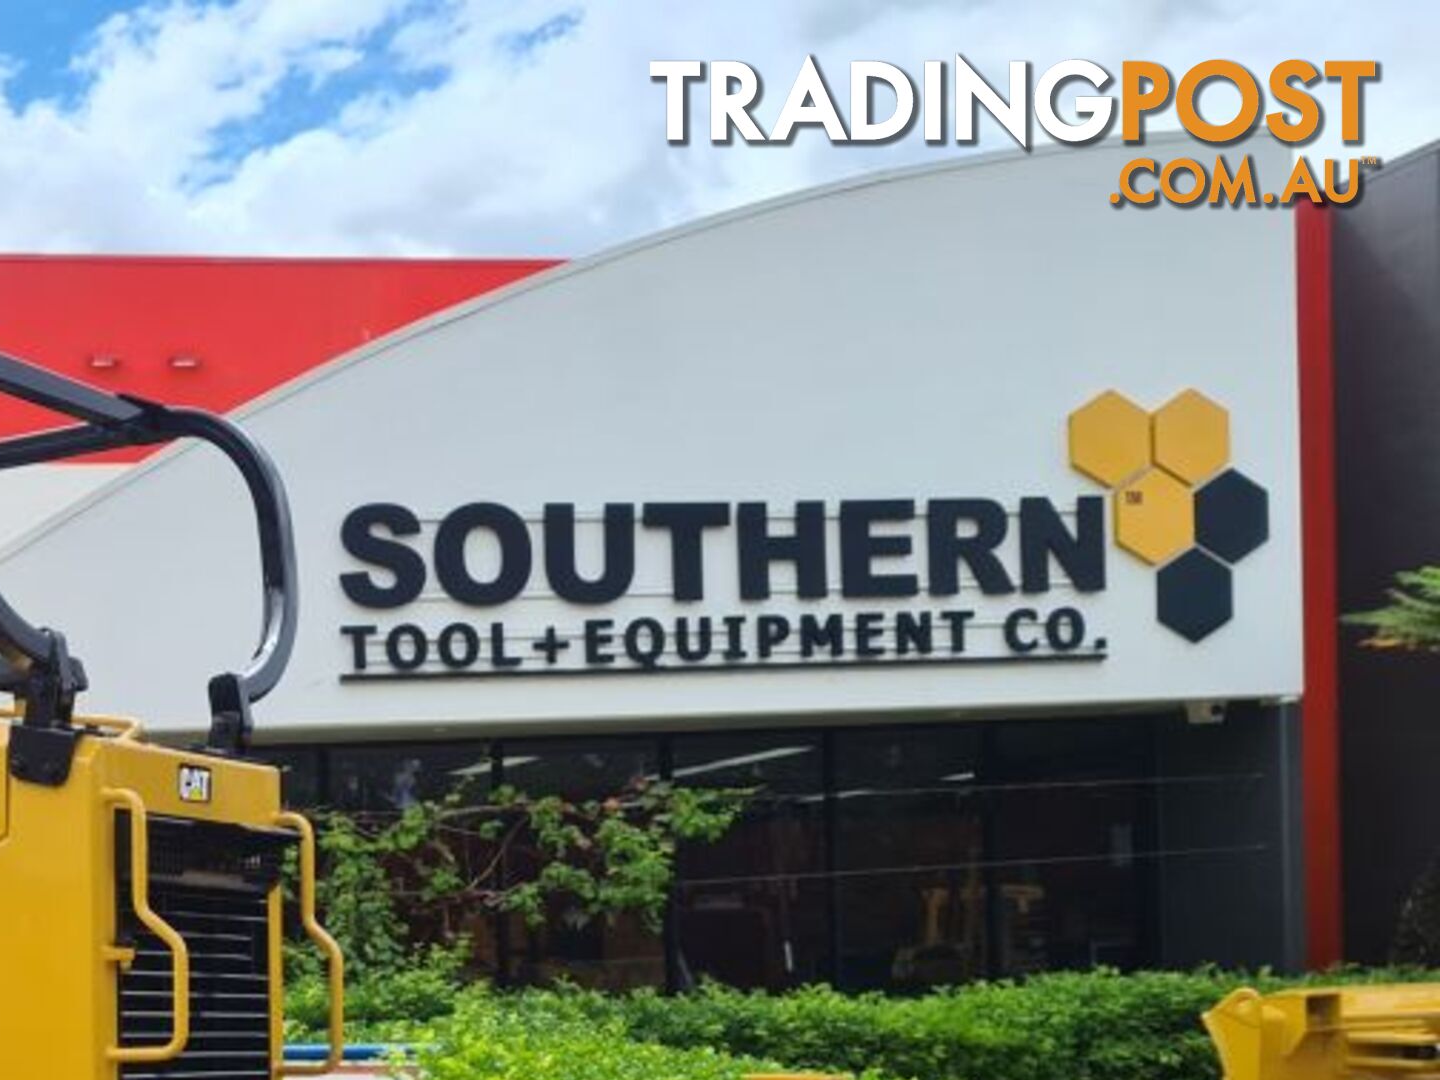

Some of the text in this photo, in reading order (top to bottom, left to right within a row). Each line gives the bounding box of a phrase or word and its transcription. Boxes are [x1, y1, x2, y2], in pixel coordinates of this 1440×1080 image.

[339, 495, 1107, 609] SOUTHERN
[339, 606, 1107, 671] TOOL+EQUIPMENT CO.
[180, 767, 209, 800] CAT
